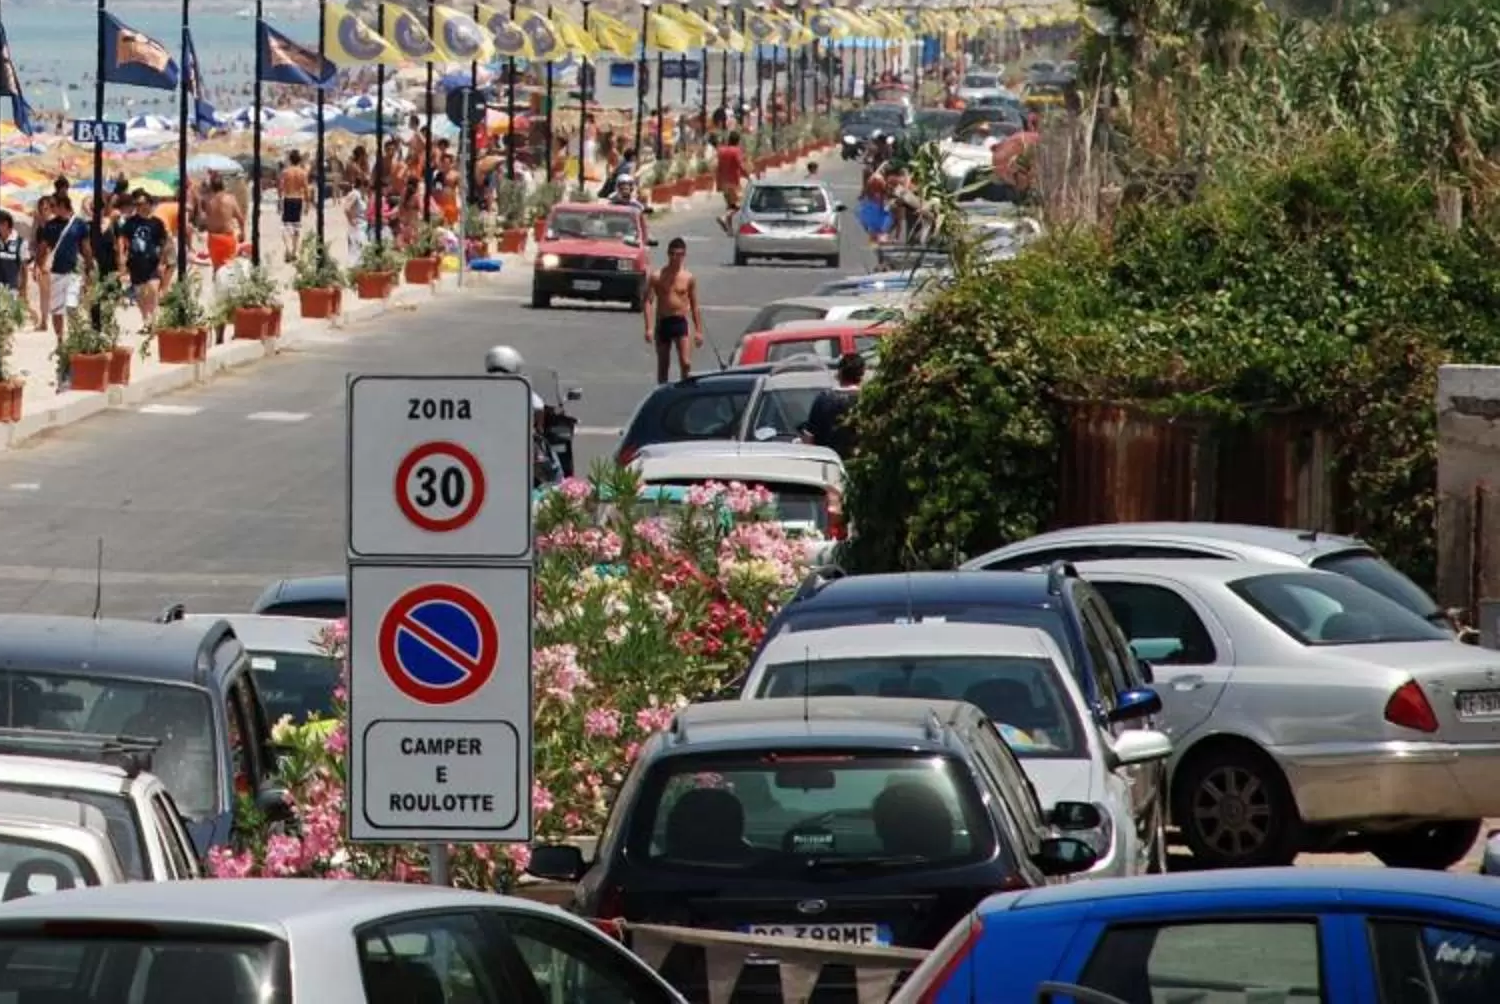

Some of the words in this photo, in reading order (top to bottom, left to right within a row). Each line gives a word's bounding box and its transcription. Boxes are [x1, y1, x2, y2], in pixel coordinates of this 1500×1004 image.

[78, 123, 120, 141] BAR
[408, 398, 472, 420] zona
[416, 466, 465, 508] 30
[401, 737, 482, 756] CAMPER
[436, 765, 447, 783] E
[389, 793, 495, 812] ROULOTTE
